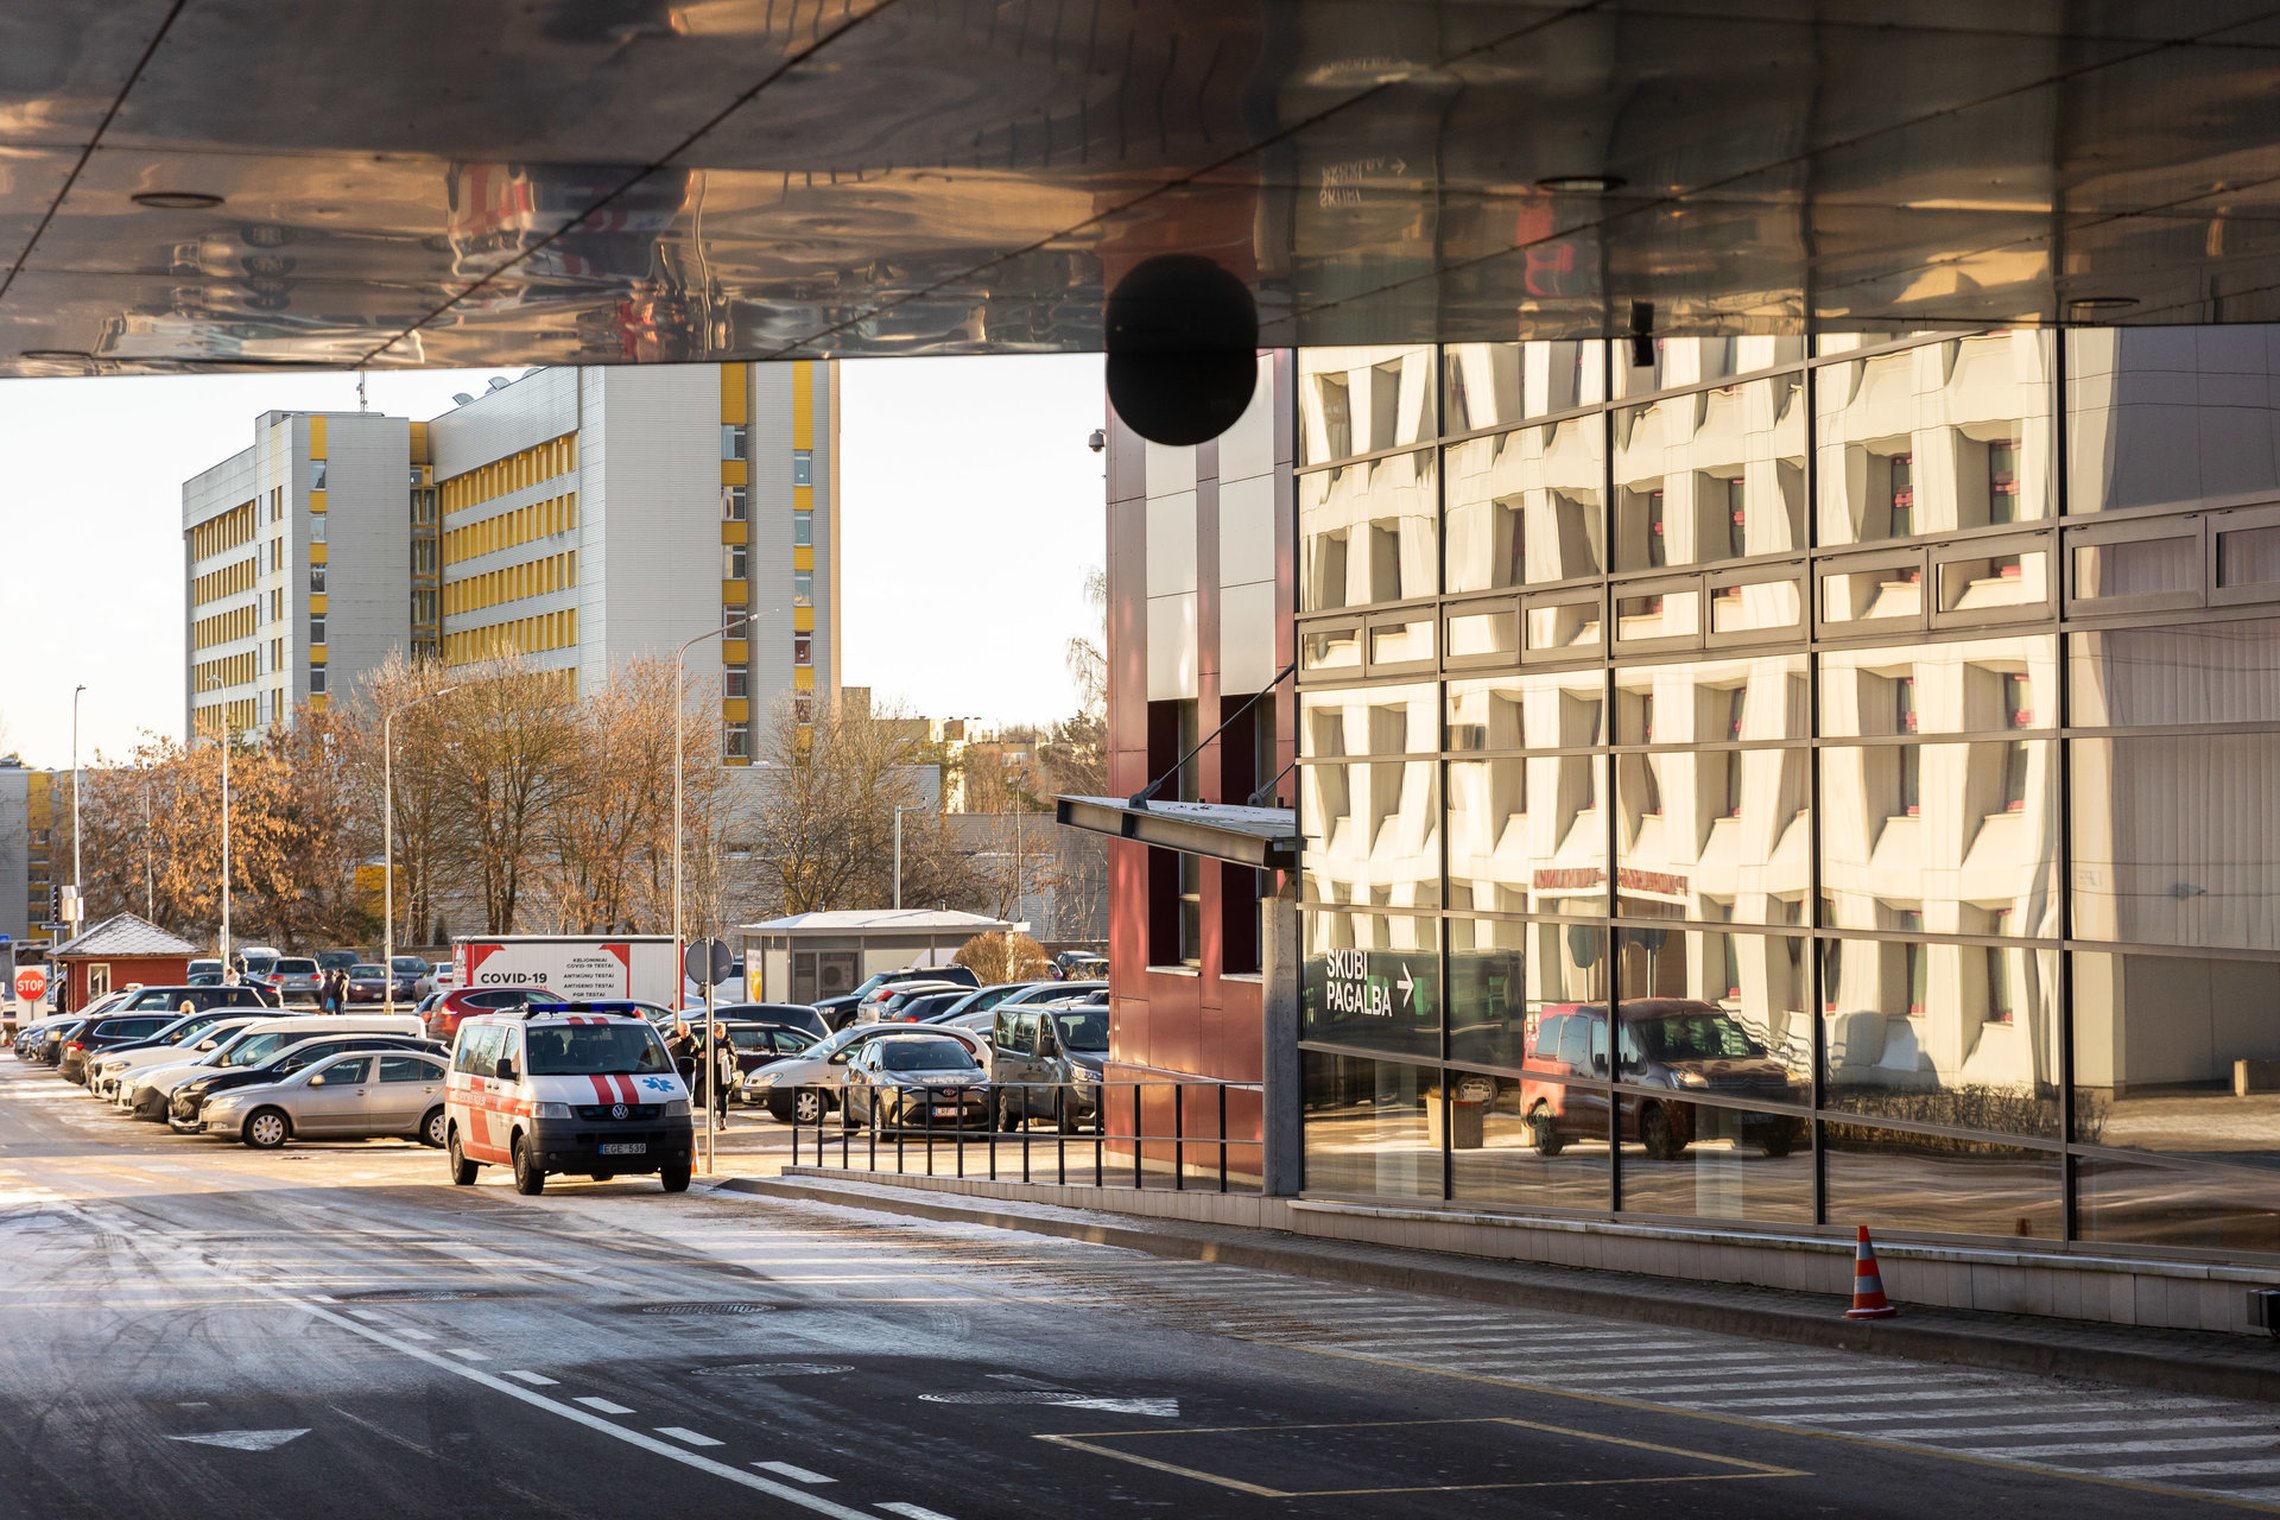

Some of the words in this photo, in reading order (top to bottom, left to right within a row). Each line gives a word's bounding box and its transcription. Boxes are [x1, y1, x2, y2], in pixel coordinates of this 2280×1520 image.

[1326, 948, 1368, 981] SKUBI
[17, 980, 44, 992] STOP
[480, 972, 548, 984] COVID-19
[1326, 981, 1393, 1018] PAGALBA
